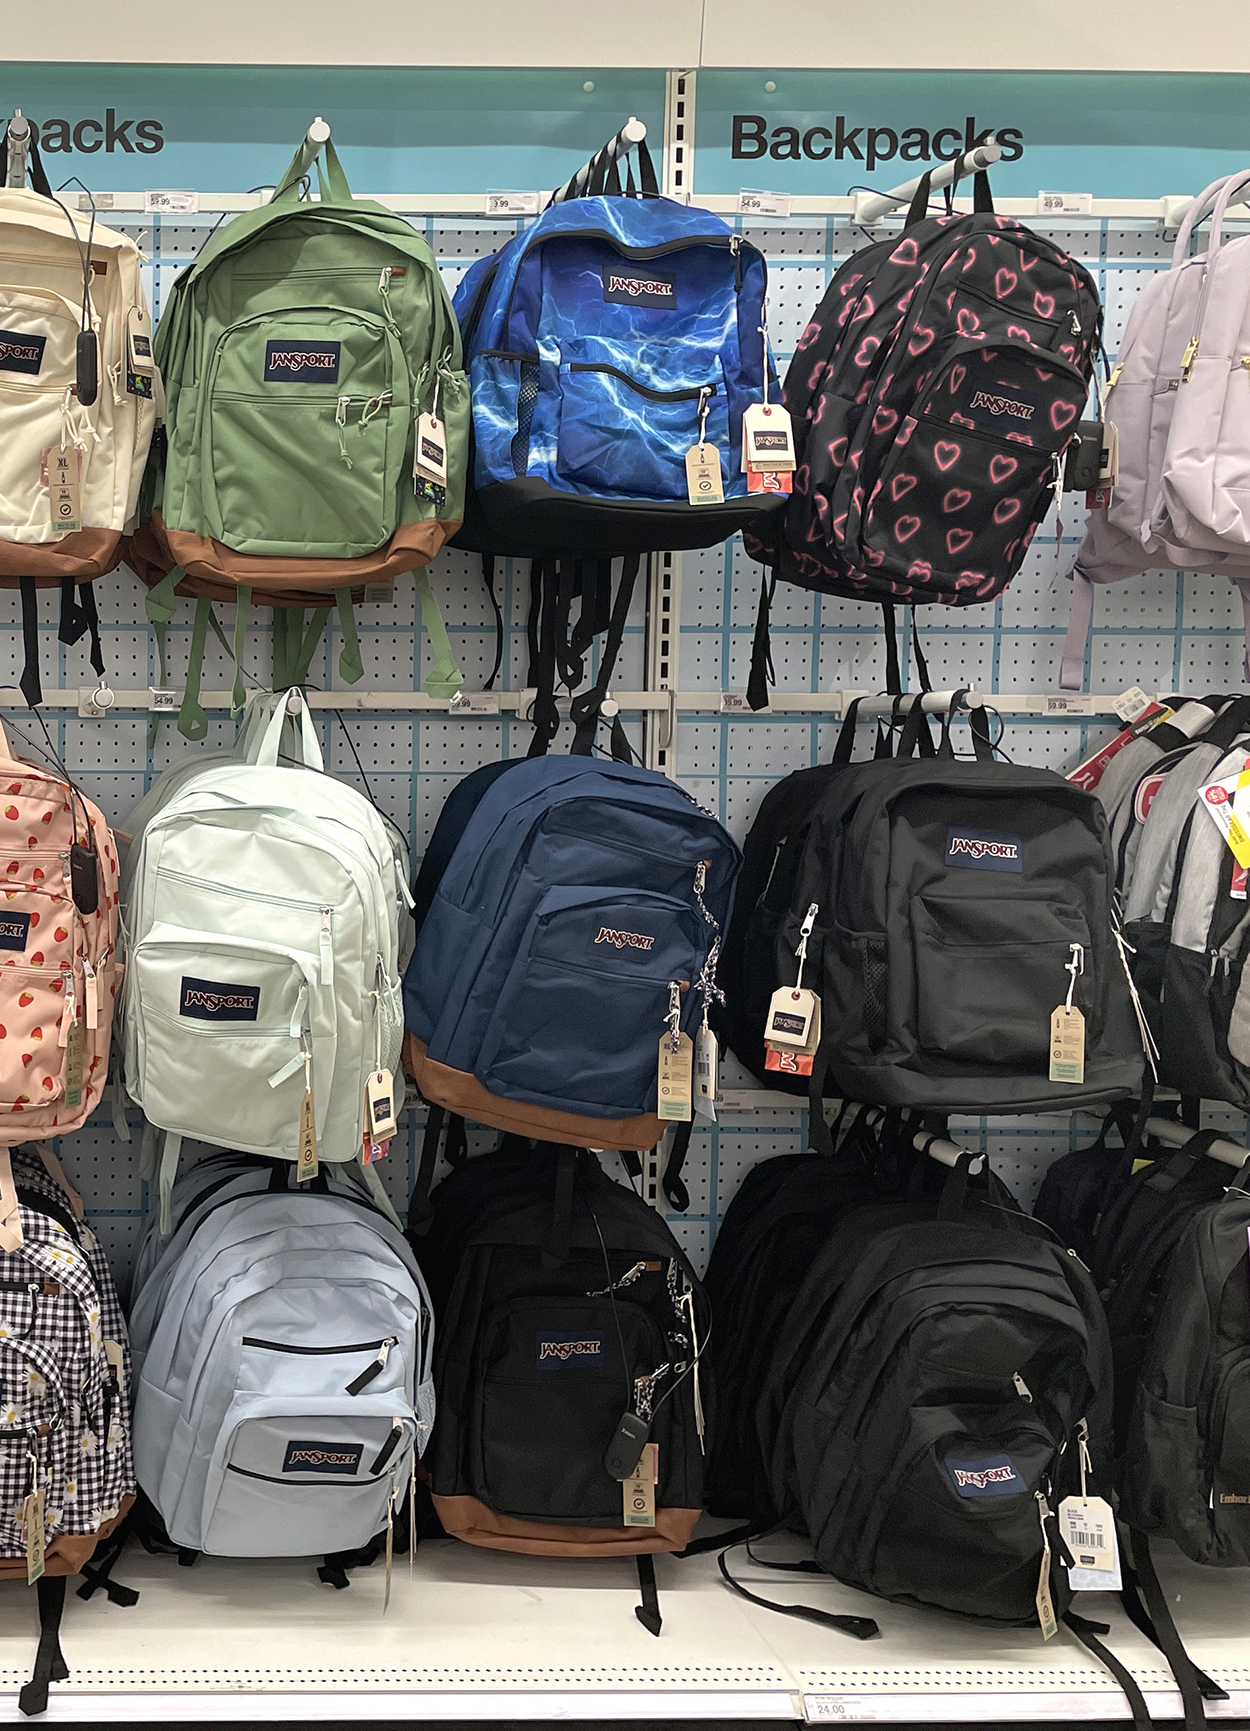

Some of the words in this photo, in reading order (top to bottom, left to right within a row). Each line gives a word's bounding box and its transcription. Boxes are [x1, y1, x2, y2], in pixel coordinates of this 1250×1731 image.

[730, 115, 1024, 171] Backpacks
[609, 275, 673, 296] JANSPORT
[269, 352, 336, 371] JANSPORT
[969, 391, 1035, 420] JANSPORT
[949, 837, 1018, 859] JANSPORT
[595, 927, 655, 950] JANSPORT
[184, 989, 254, 1012] JANSPORT
[539, 1340, 600, 1360] JANSPORT
[288, 1450, 358, 1465] JANSPORT
[817, 1704, 845, 1714] 24.00
